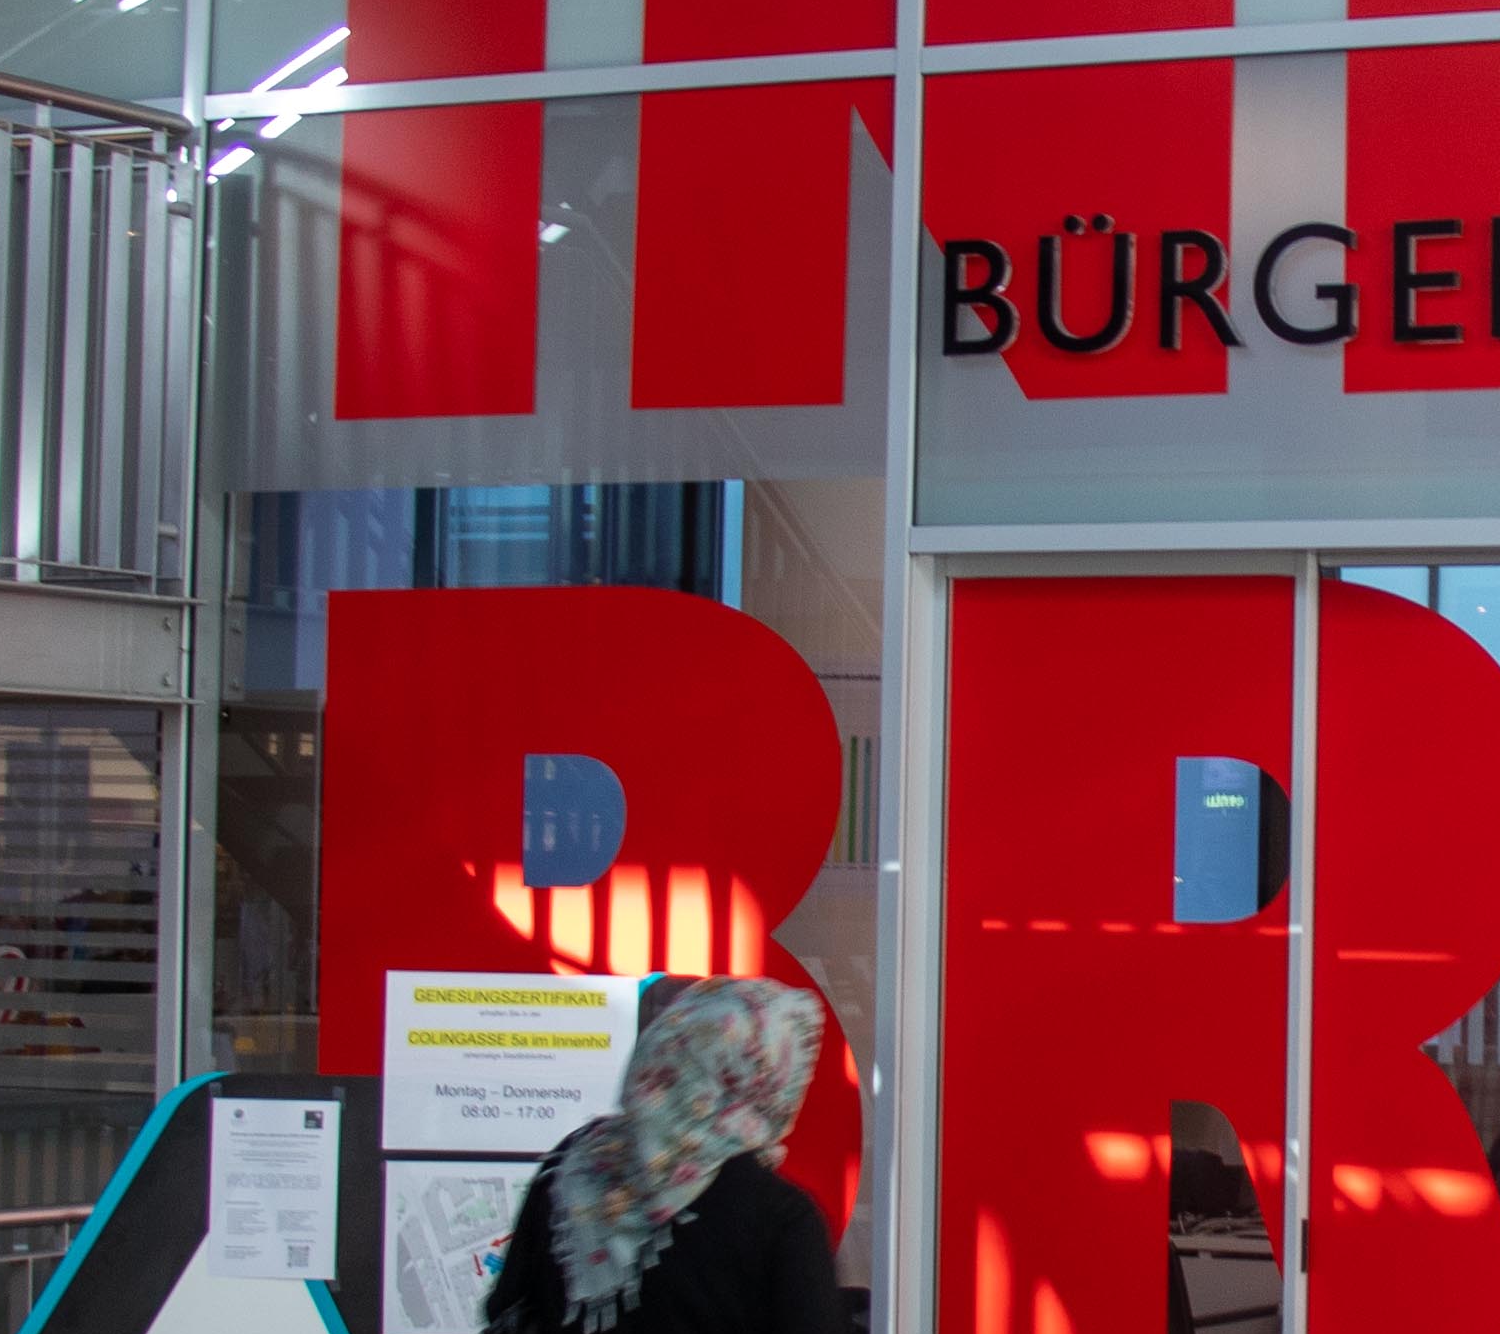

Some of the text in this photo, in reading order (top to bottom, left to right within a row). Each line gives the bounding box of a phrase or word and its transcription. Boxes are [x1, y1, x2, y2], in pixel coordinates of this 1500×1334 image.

[414, 988, 607, 1006] GENESUNGSZERTIFIKATE
[408, 1030, 612, 1049] COLINGASSE 5a im Innenhof
[436, 1084, 487, 1100] Montag
[503, 1085, 582, 1102] Donnerstag
